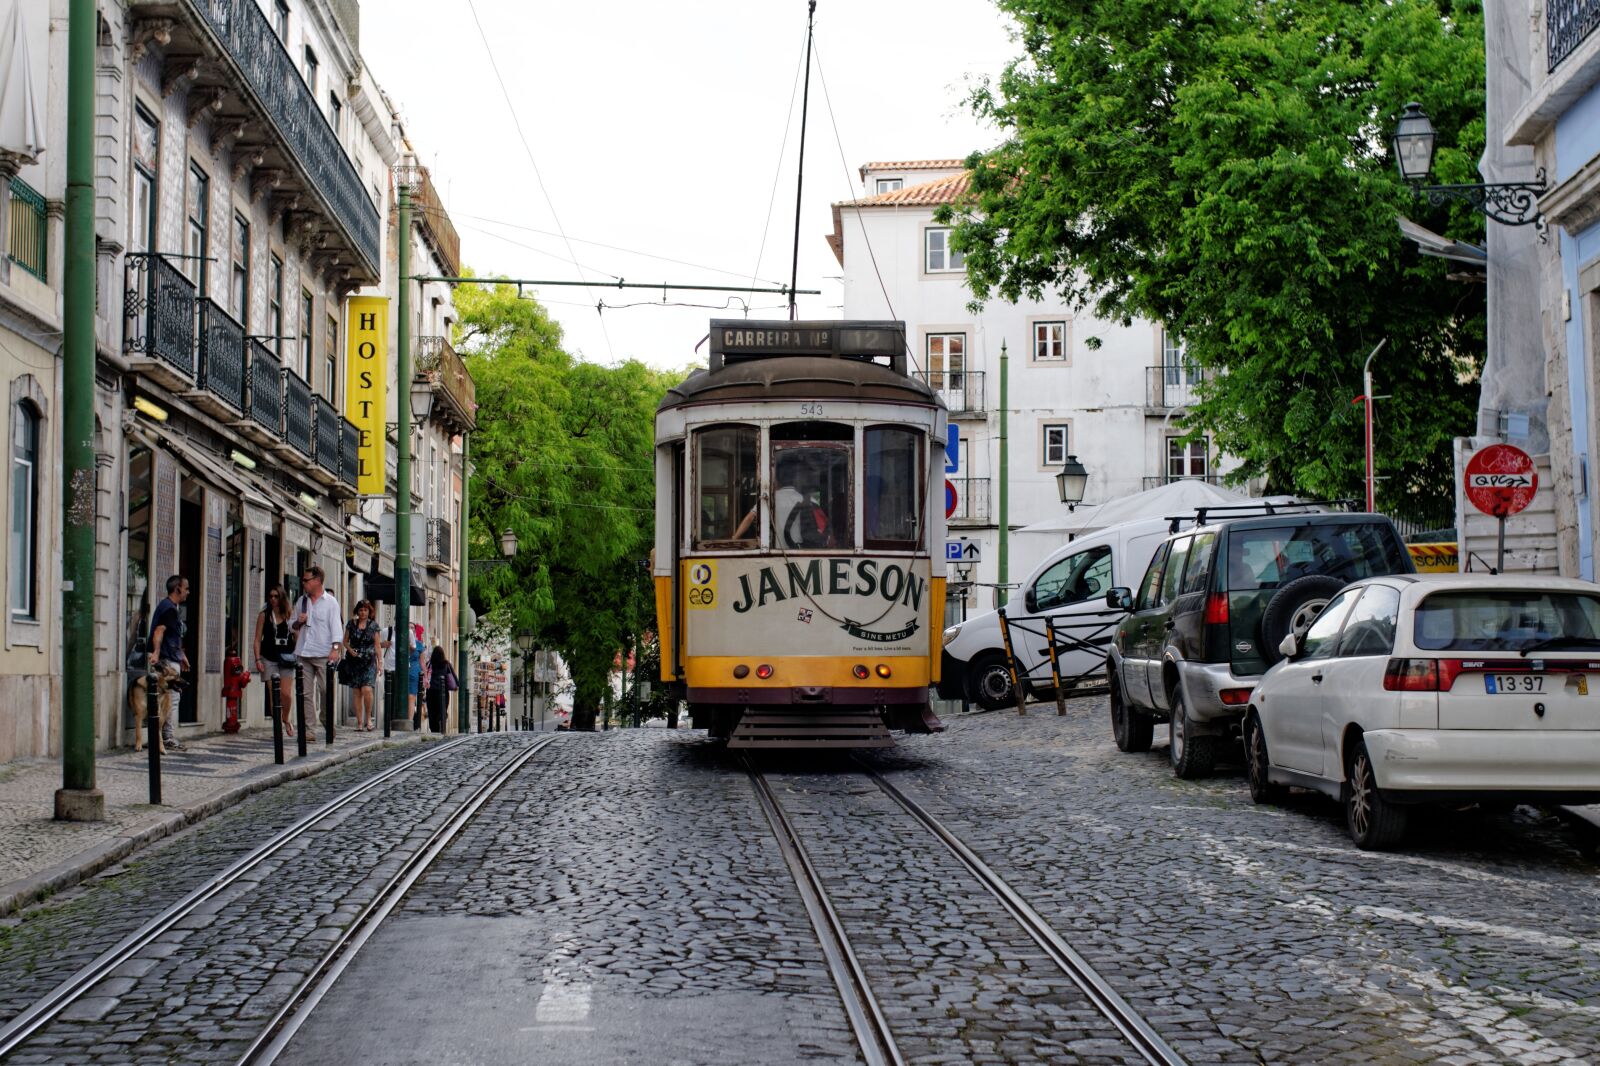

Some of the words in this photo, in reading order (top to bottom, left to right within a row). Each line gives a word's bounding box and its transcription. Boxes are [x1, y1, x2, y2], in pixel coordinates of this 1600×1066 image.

[724, 330, 800, 346] CARREIRA
[358, 313, 376, 476] HOSTEL
[801, 404, 823, 415] 543
[948, 543, 960, 559] P
[732, 558, 925, 613] JAMESON
[860, 631, 882, 641] SINE
[885, 631, 907, 641] METU
